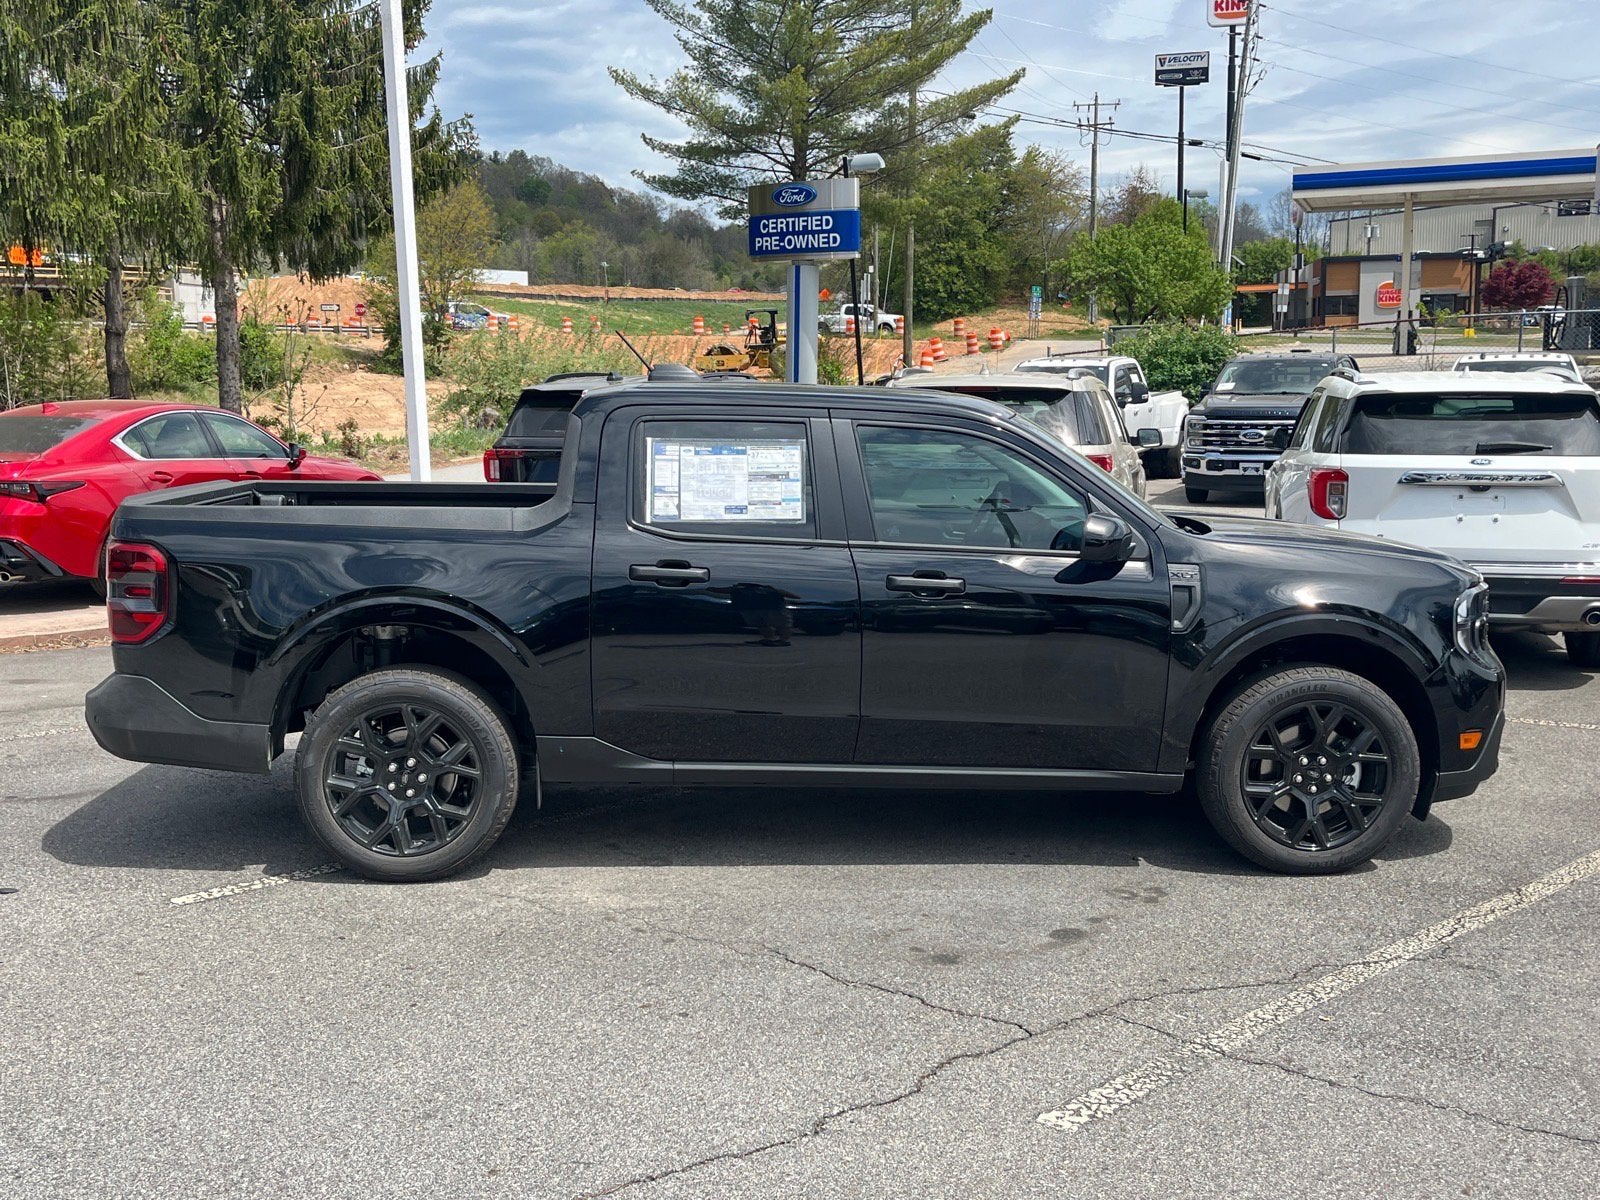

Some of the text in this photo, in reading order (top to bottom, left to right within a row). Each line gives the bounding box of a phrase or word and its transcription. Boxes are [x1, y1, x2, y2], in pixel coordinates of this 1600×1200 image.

[1214, 0, 1247, 12] KIN
[1168, 54, 1206, 64] VELOCITY
[780, 188, 805, 203] Ford
[760, 215, 833, 234] CERTIFIED
[755, 233, 841, 251] PRE-OWNED
[1378, 295, 1402, 303] KING
[697, 486, 732, 498] TOUGH
[1170, 571, 1198, 579] XLT
[1267, 684, 1328, 706] WRANGLER
